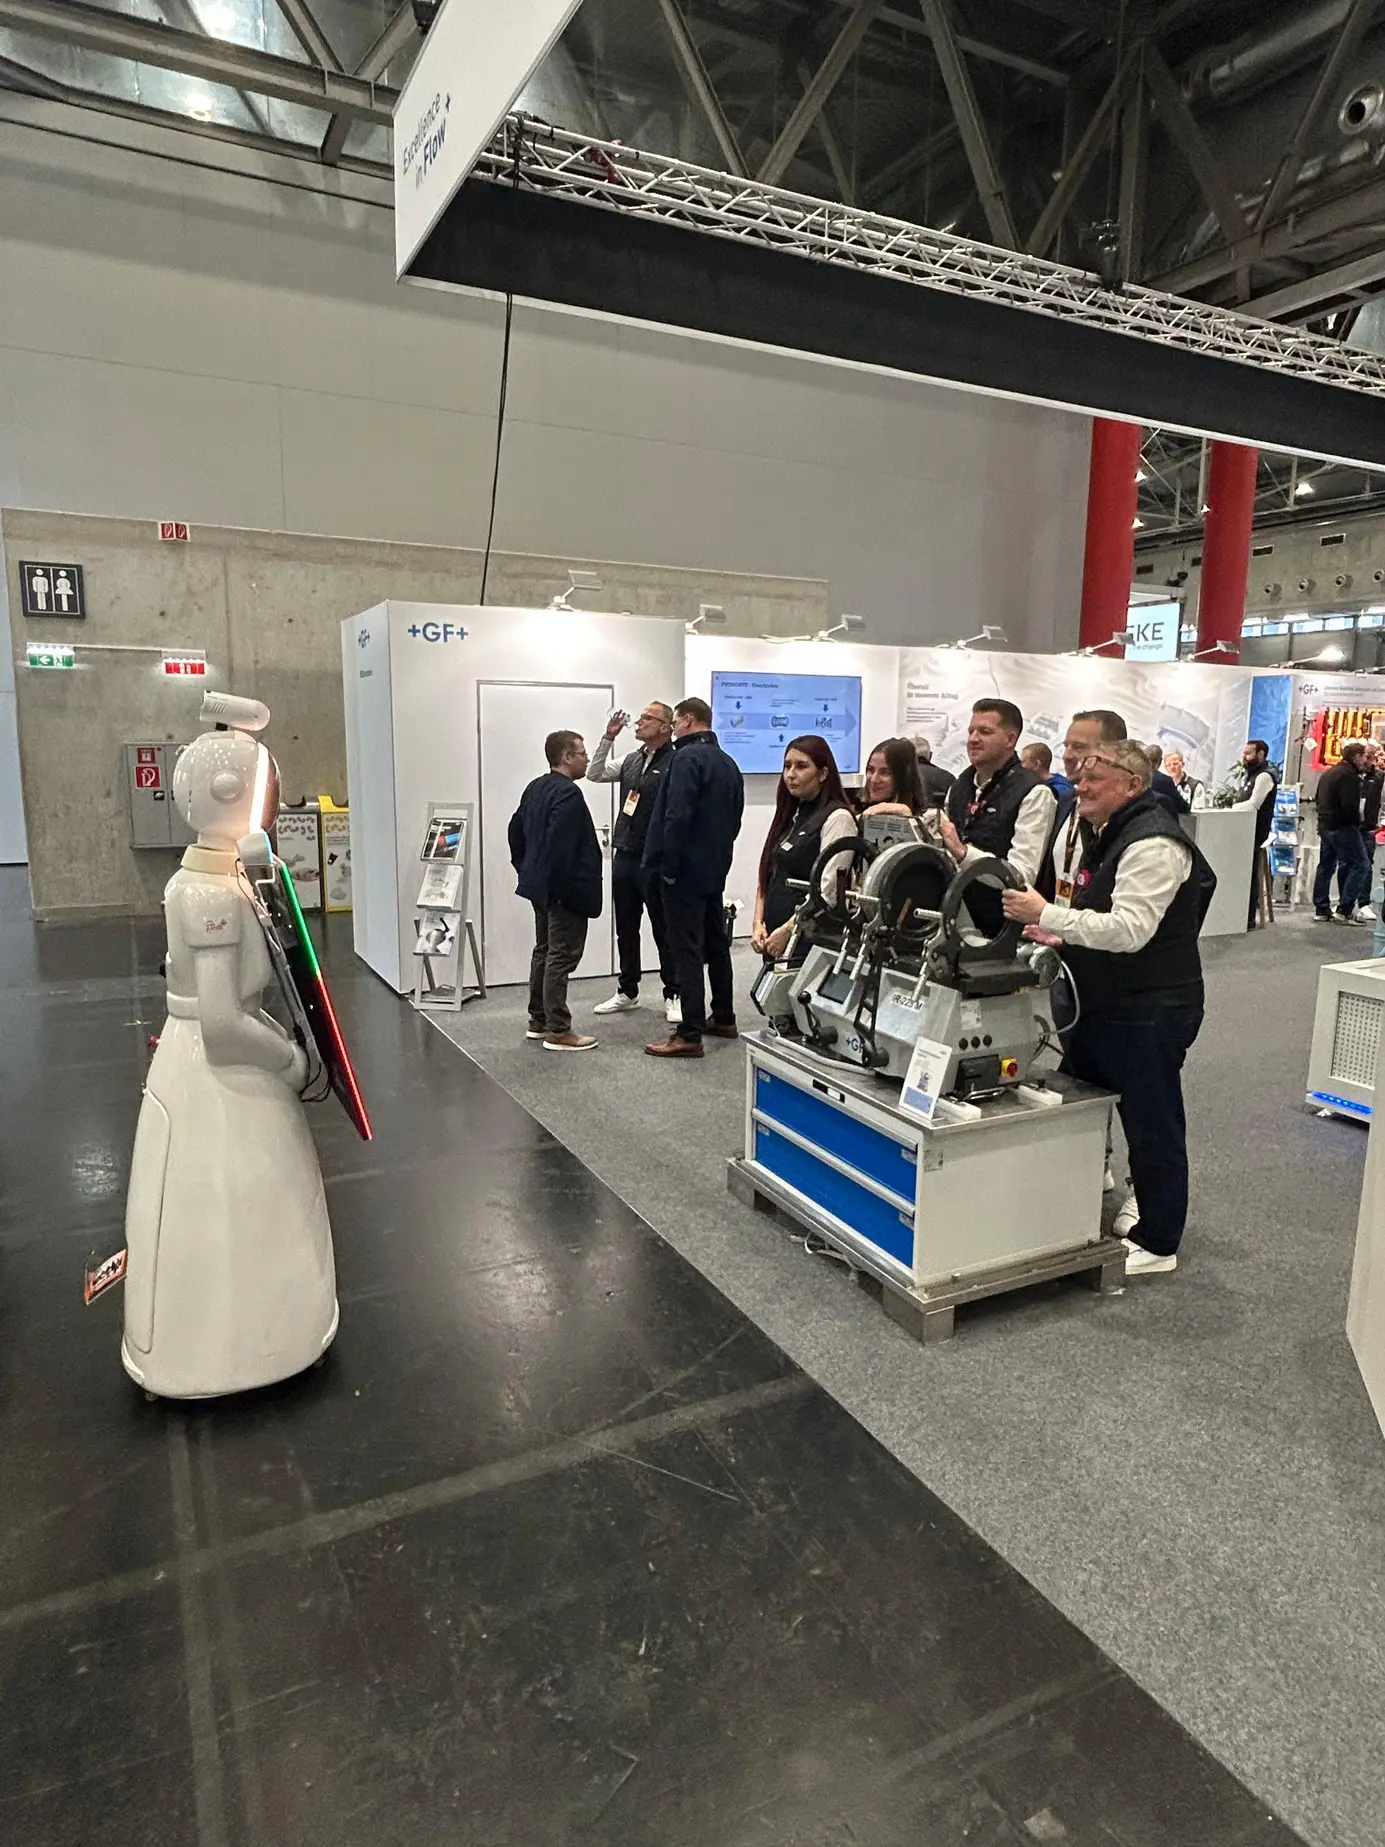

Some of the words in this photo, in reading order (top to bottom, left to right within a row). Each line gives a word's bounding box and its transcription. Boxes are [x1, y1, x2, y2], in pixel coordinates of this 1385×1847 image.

[403, 92, 441, 175] Excellence
[415, 164, 423, 190] in
[424, 118, 447, 177] Flow
